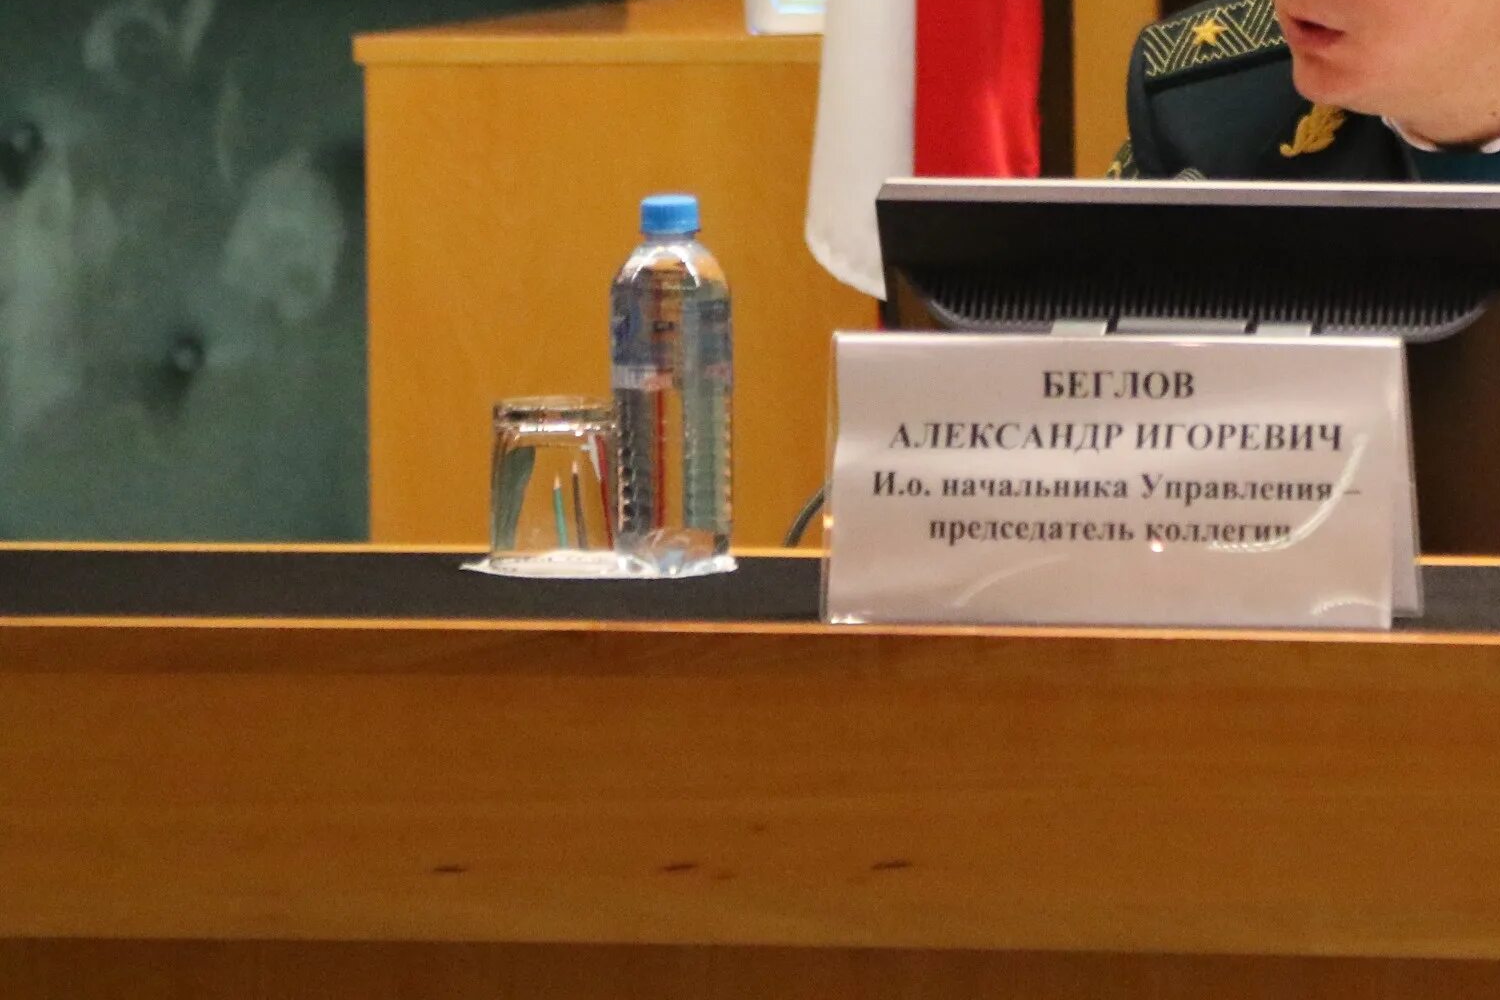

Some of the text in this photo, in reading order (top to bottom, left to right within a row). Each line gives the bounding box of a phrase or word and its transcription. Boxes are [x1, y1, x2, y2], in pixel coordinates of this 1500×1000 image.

[1042, 370, 1195, 399] БЕГЛОВ
[889, 422, 1342, 454] АЛЕКСАНДР ИГОРЕВИЧ
[872, 470, 931, 497] И.о.
[941, 477, 1129, 499] начальника
[1140, 472, 1333, 507] Управления
[928, 518, 1135, 547] председатель
